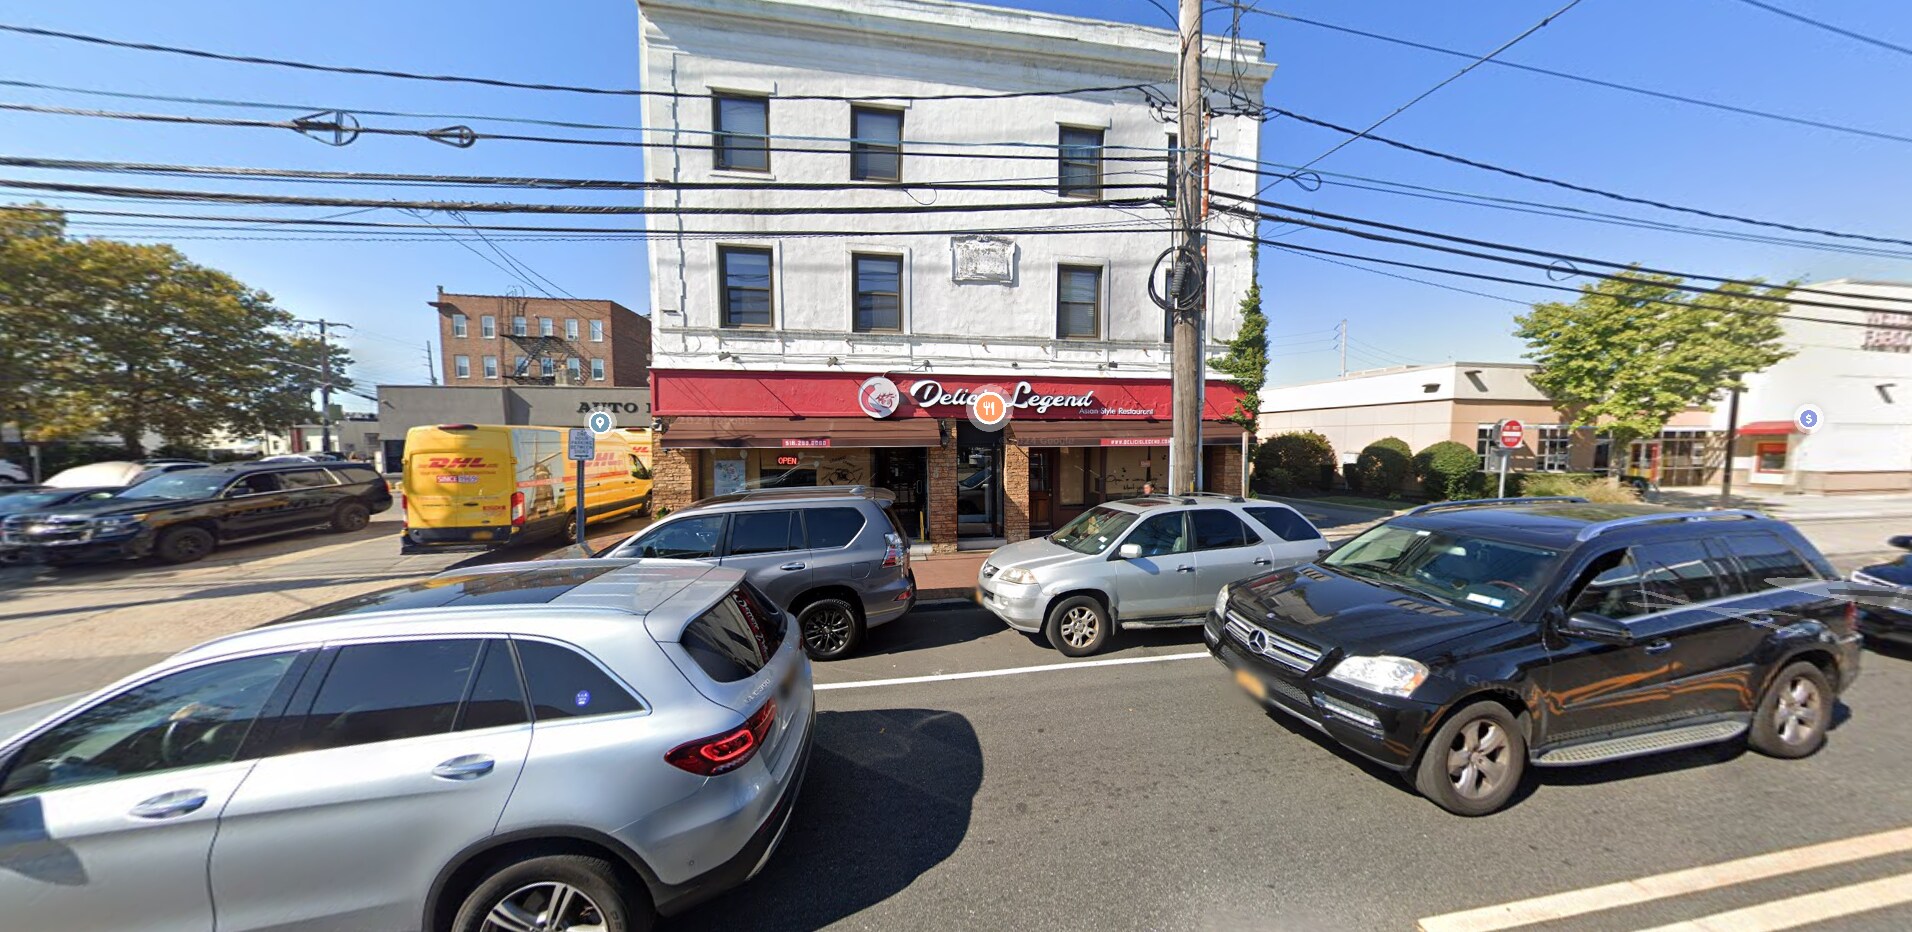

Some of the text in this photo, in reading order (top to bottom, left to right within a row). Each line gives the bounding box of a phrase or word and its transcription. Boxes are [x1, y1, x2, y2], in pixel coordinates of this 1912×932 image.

[910, 379, 986, 408] Delic
[1005, 381, 1094, 413] Legend
[1079, 407, 1154, 416] Asian Style Restaurant
[428, 457, 487, 468] DHL
[778, 457, 797, 465] OPEN
